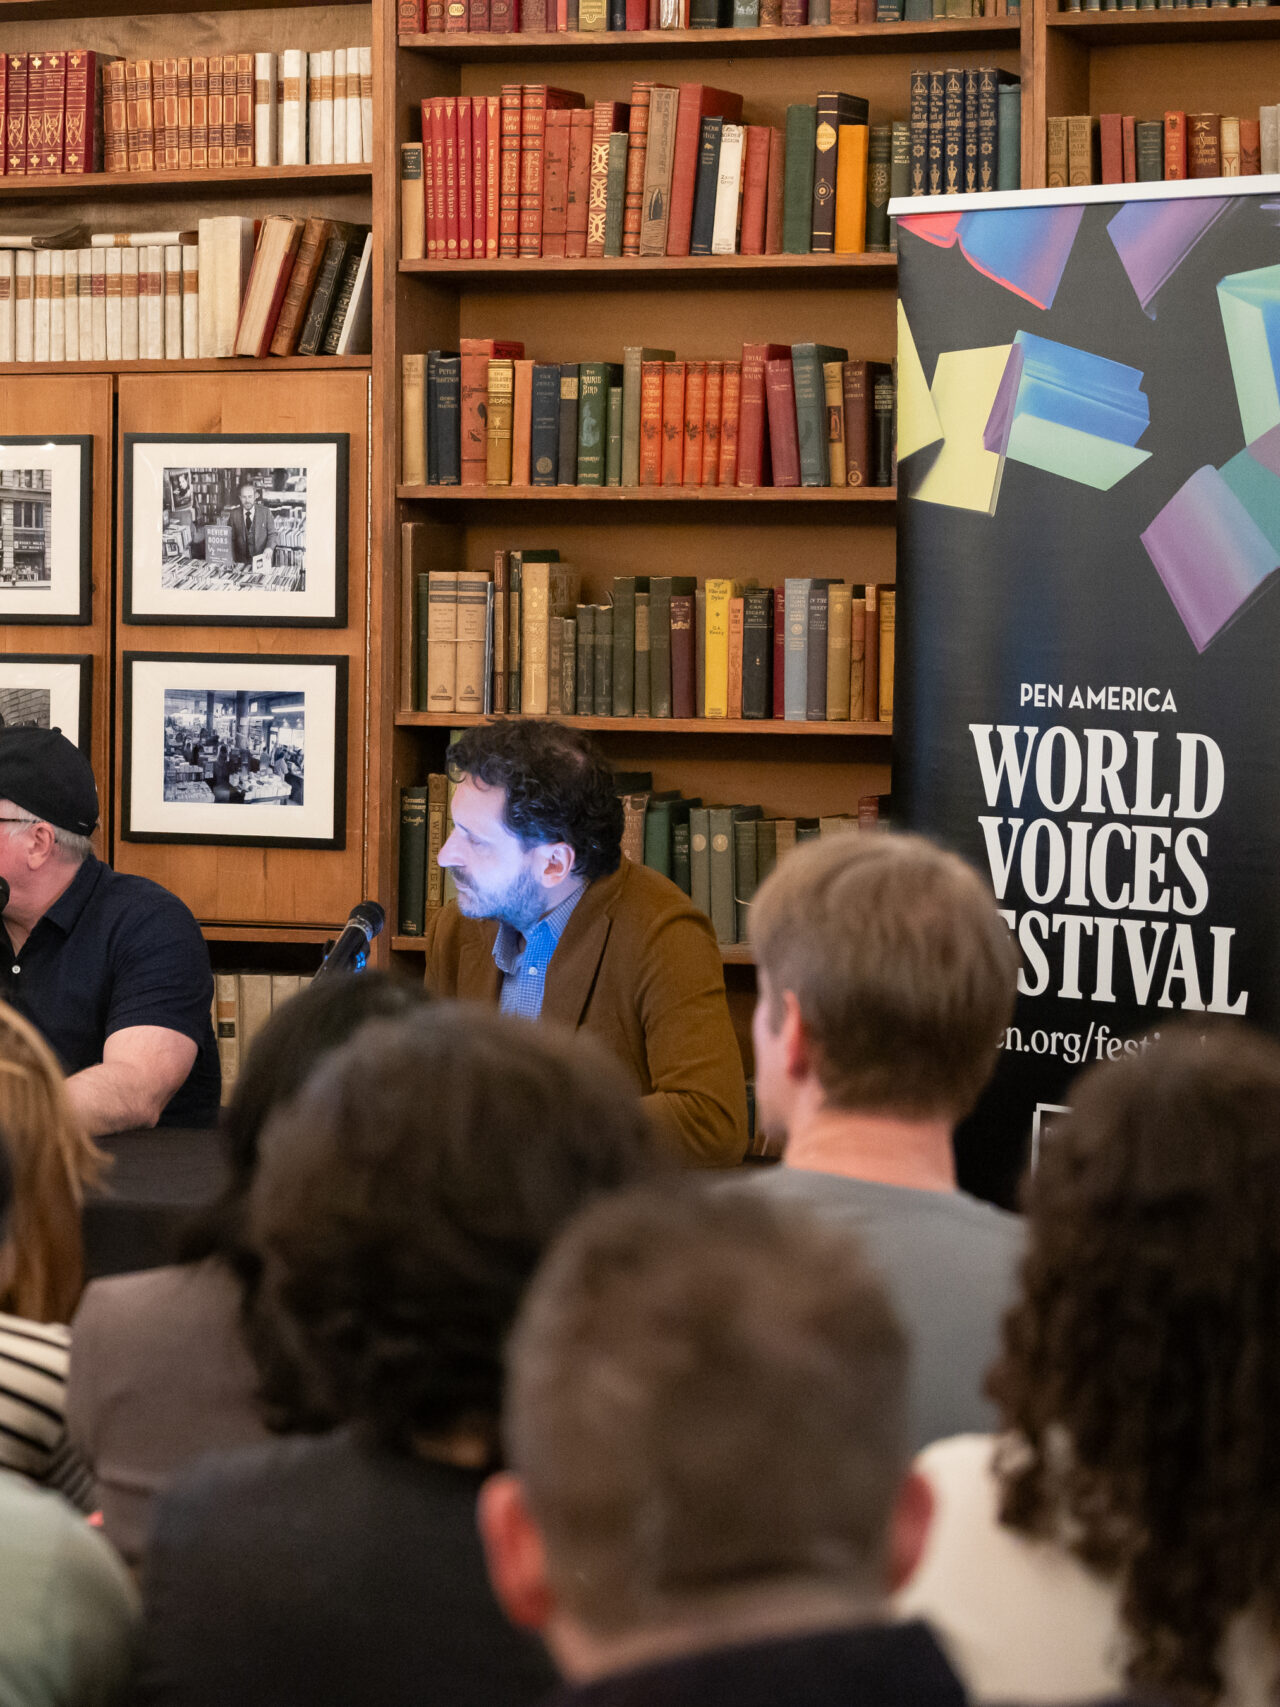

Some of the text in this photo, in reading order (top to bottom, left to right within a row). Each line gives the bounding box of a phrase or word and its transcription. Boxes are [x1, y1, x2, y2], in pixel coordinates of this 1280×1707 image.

[207, 528, 229, 536] REVIEW
[208, 536, 228, 545] BOOKS
[1020, 682, 1178, 713] PEN AMERICA
[968, 723, 1226, 819] WORLD
[430, 820, 440, 892] WHITTIER
[977, 815, 1209, 916] VOICES
[995, 908, 1250, 1016] STIVAL
